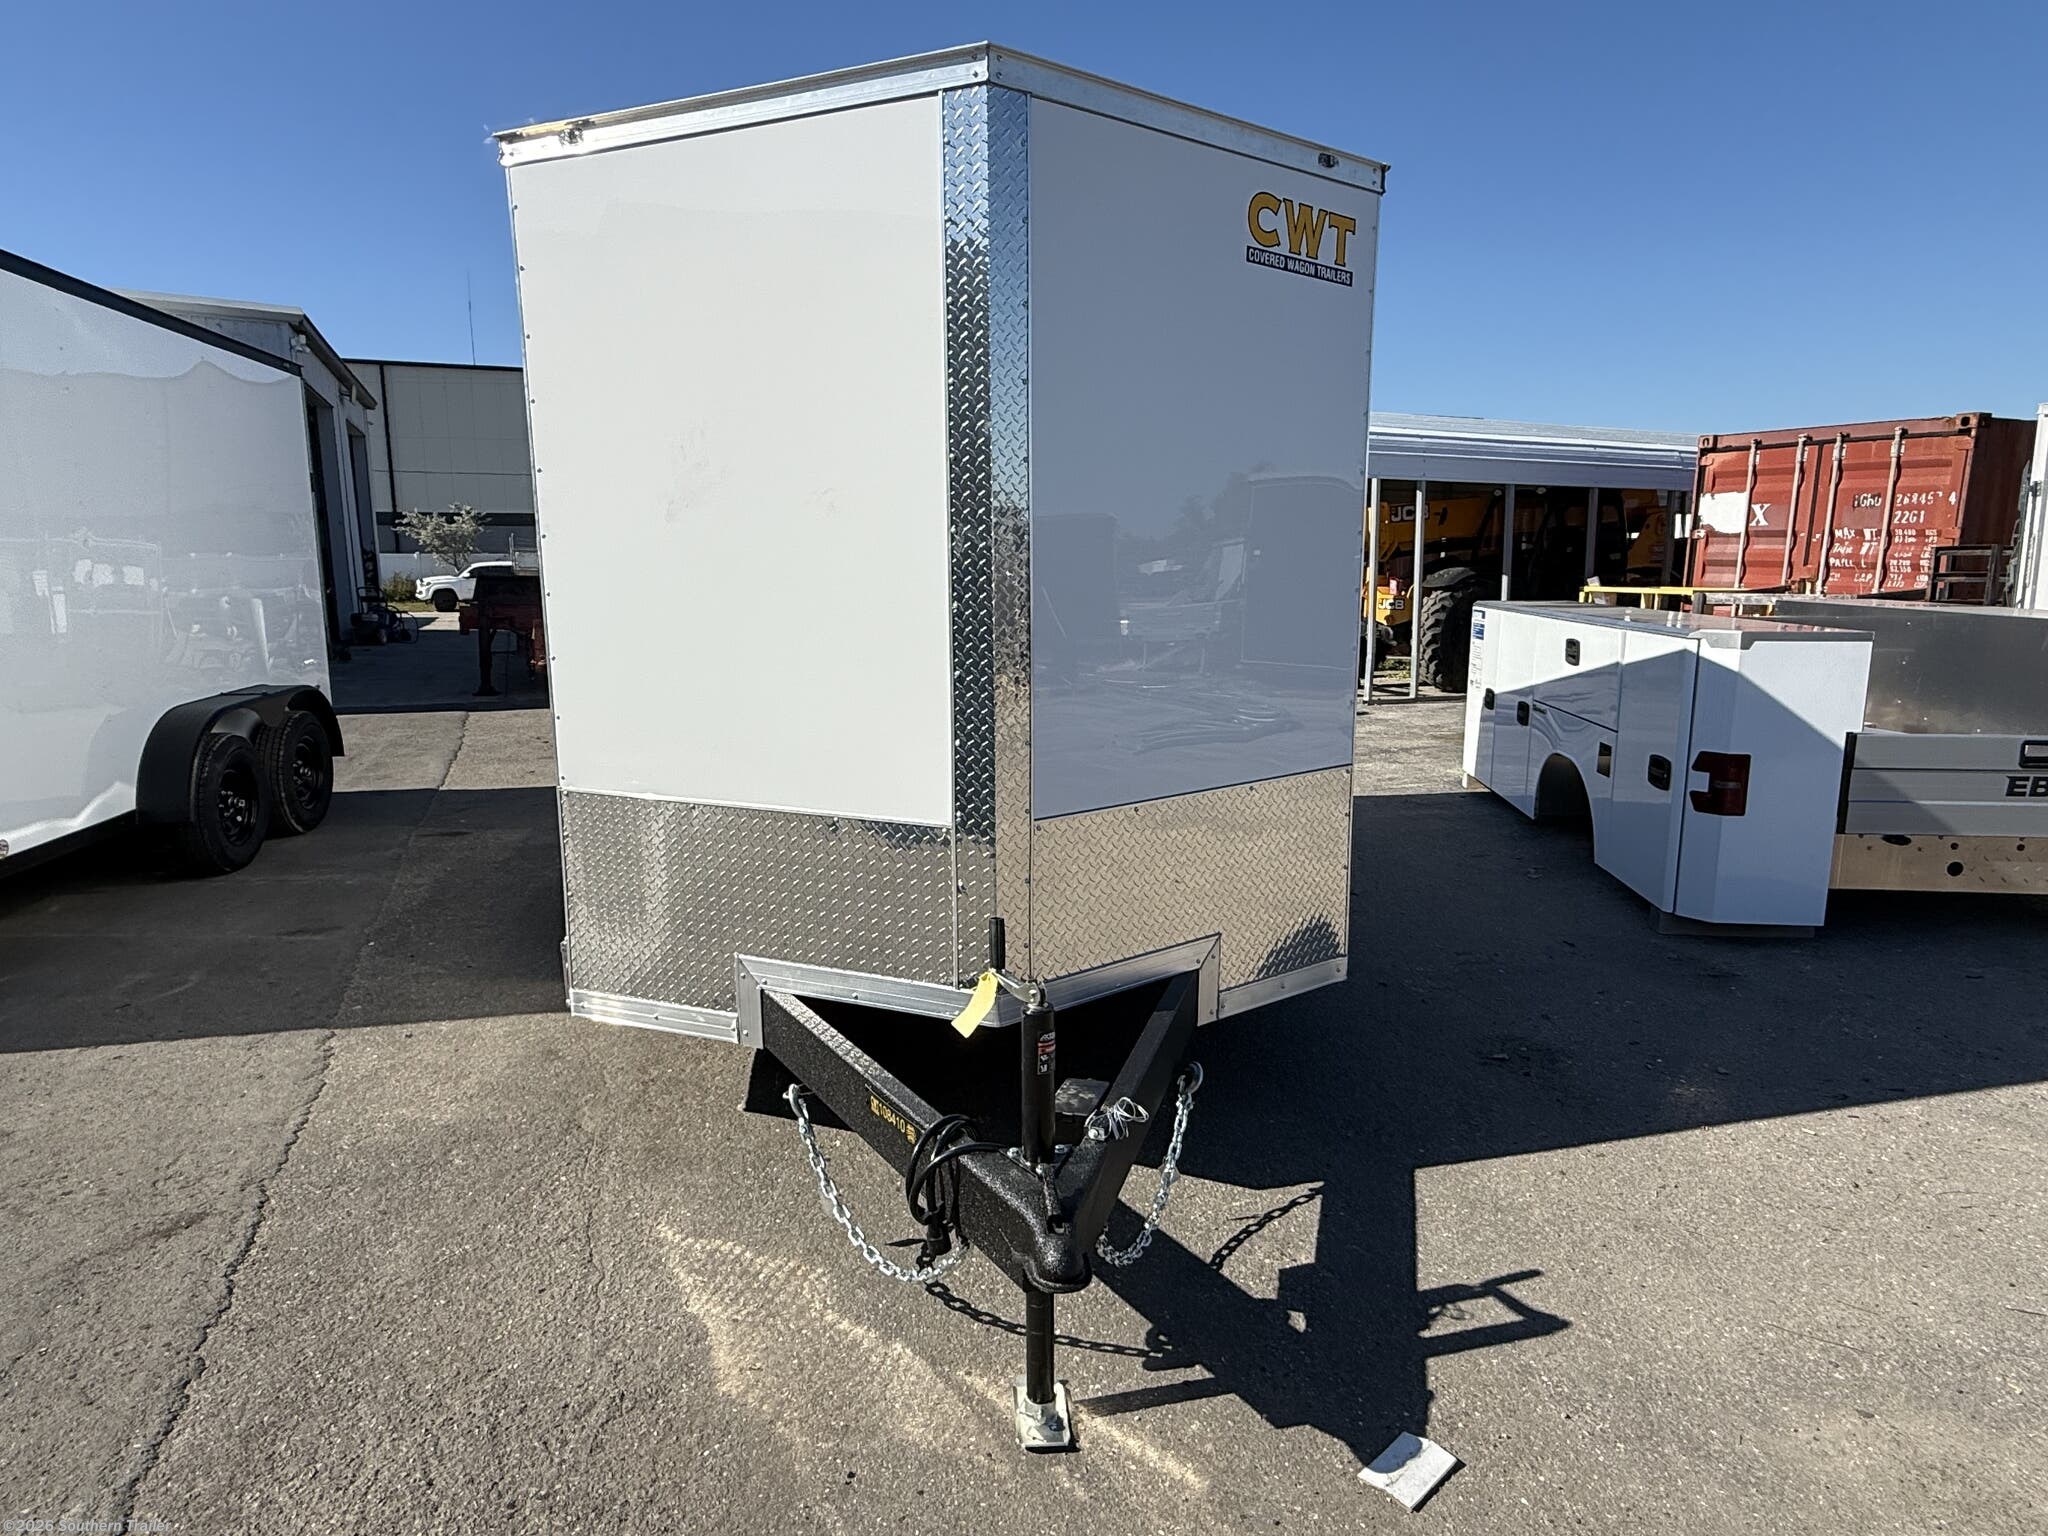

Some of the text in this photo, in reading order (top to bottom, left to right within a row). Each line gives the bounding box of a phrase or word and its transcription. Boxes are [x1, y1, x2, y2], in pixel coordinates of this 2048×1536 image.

[1248, 191, 1357, 267] CWT
[1248, 248, 1352, 285] COVERED WAGON TRAILERS
[1749, 503, 1771, 526] X
[1893, 510, 1925, 524] 22G1
[1378, 599, 1405, 610] JCB
